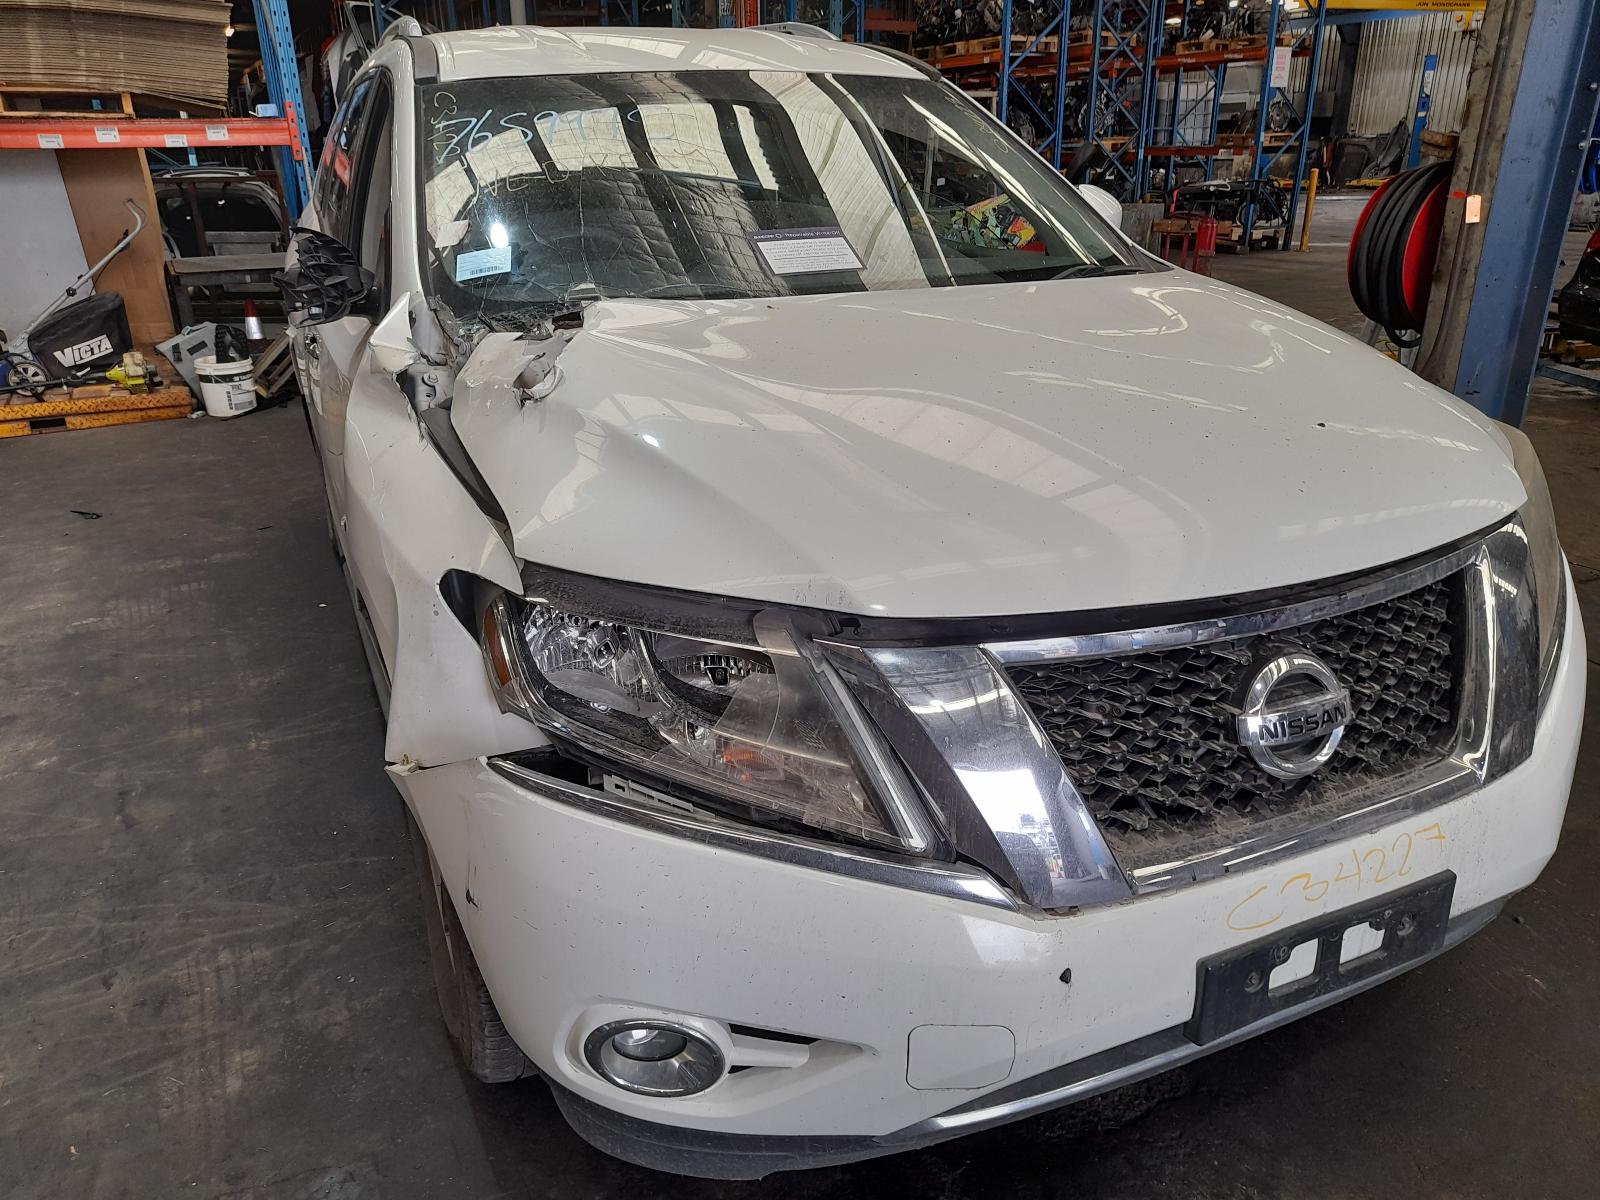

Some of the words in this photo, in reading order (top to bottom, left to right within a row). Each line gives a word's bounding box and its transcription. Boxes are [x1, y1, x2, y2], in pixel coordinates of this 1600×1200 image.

[53, 334, 114, 367] VICTA
[1258, 703, 1348, 741] NISSAN
[1226, 822, 1447, 930] C34227
